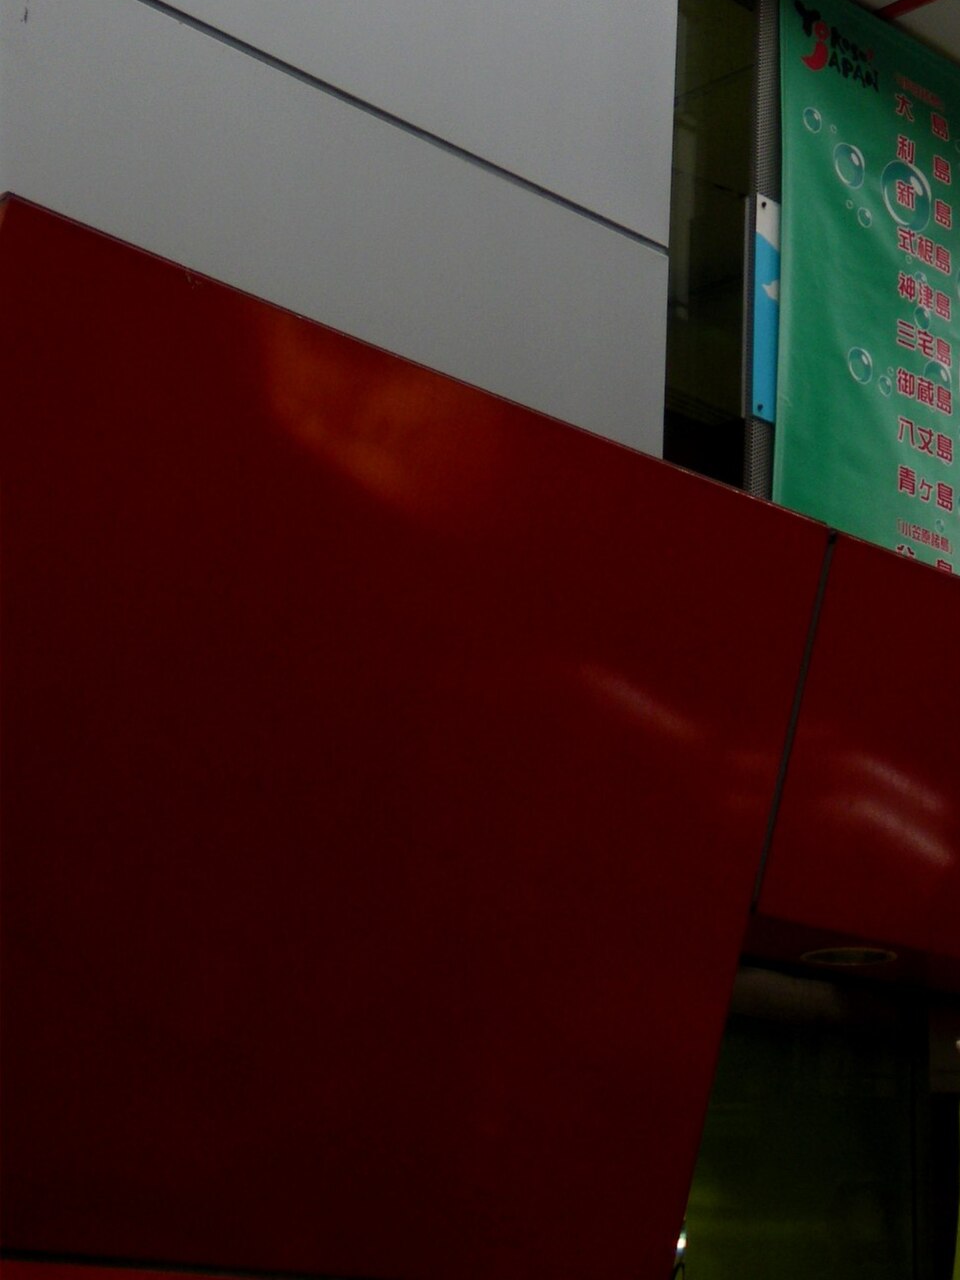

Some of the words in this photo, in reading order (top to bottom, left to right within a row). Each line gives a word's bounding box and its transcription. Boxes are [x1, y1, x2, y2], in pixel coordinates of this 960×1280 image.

[896, 226, 952, 275] 式根島
[896, 271, 952, 321] 神津島
[896, 319, 952, 368] 三宅島
[896, 367, 953, 416] 御蔵島
[896, 415, 953, 464] 八丈島
